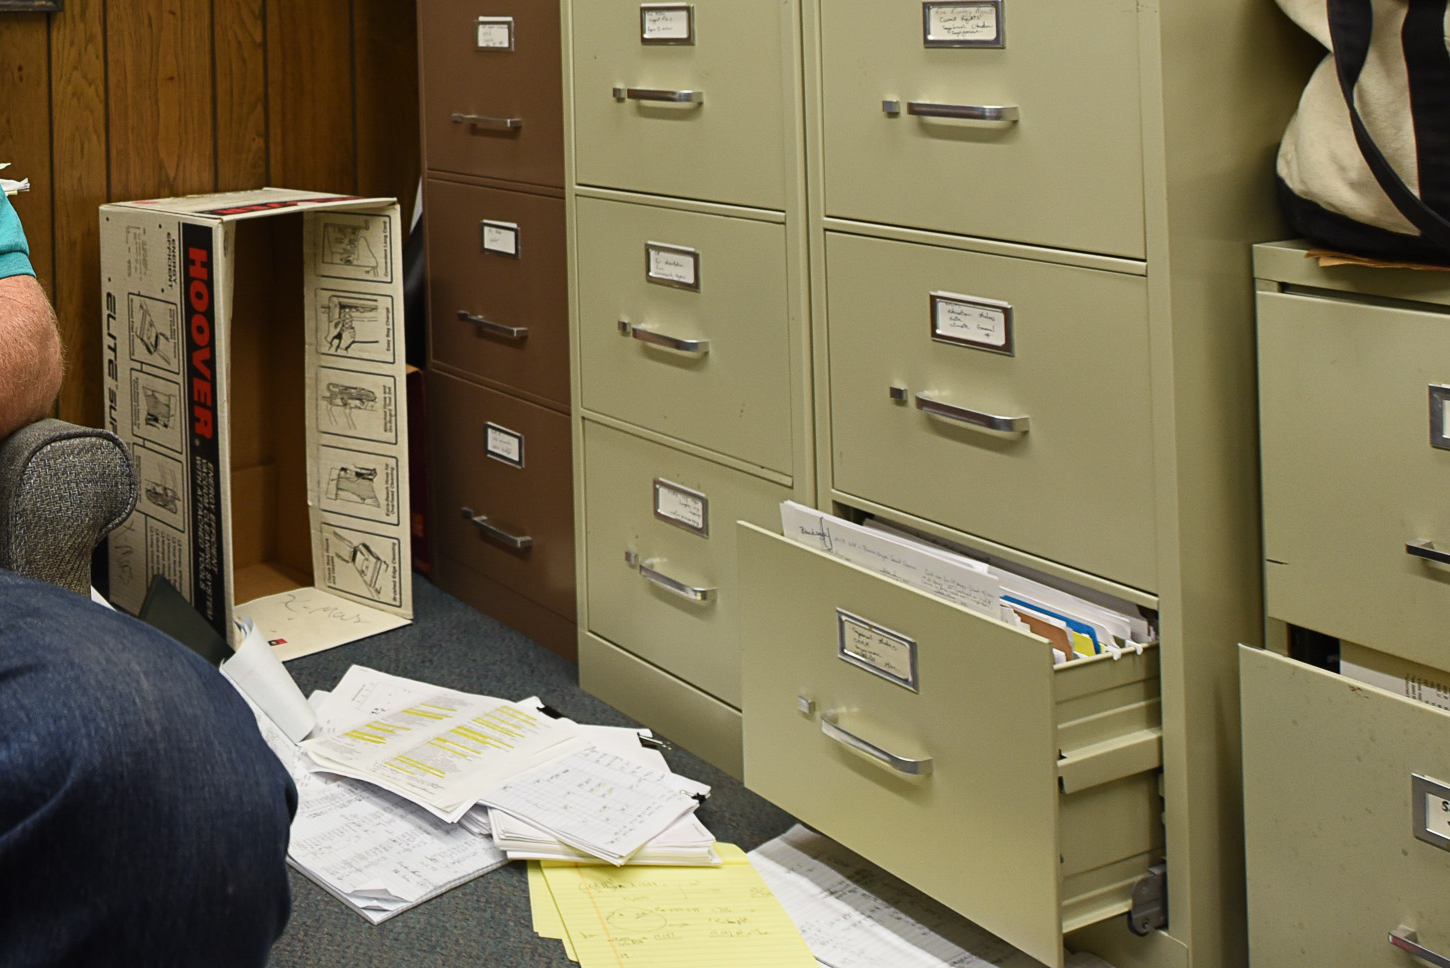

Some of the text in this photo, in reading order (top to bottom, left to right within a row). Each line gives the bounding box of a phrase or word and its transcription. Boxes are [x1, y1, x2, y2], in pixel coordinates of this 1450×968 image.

[166, 232, 174, 291] EFFICIENT
[106, 292, 119, 434] ELITE SUP
[189, 246, 213, 440] HOOVER
[195, 456, 207, 590] WITH ATTACHED TOOLS
[201, 459, 213, 620] VACUUM CLEANING SYSTEM
[207, 462, 219, 574] ENERGY EFFICIENT
